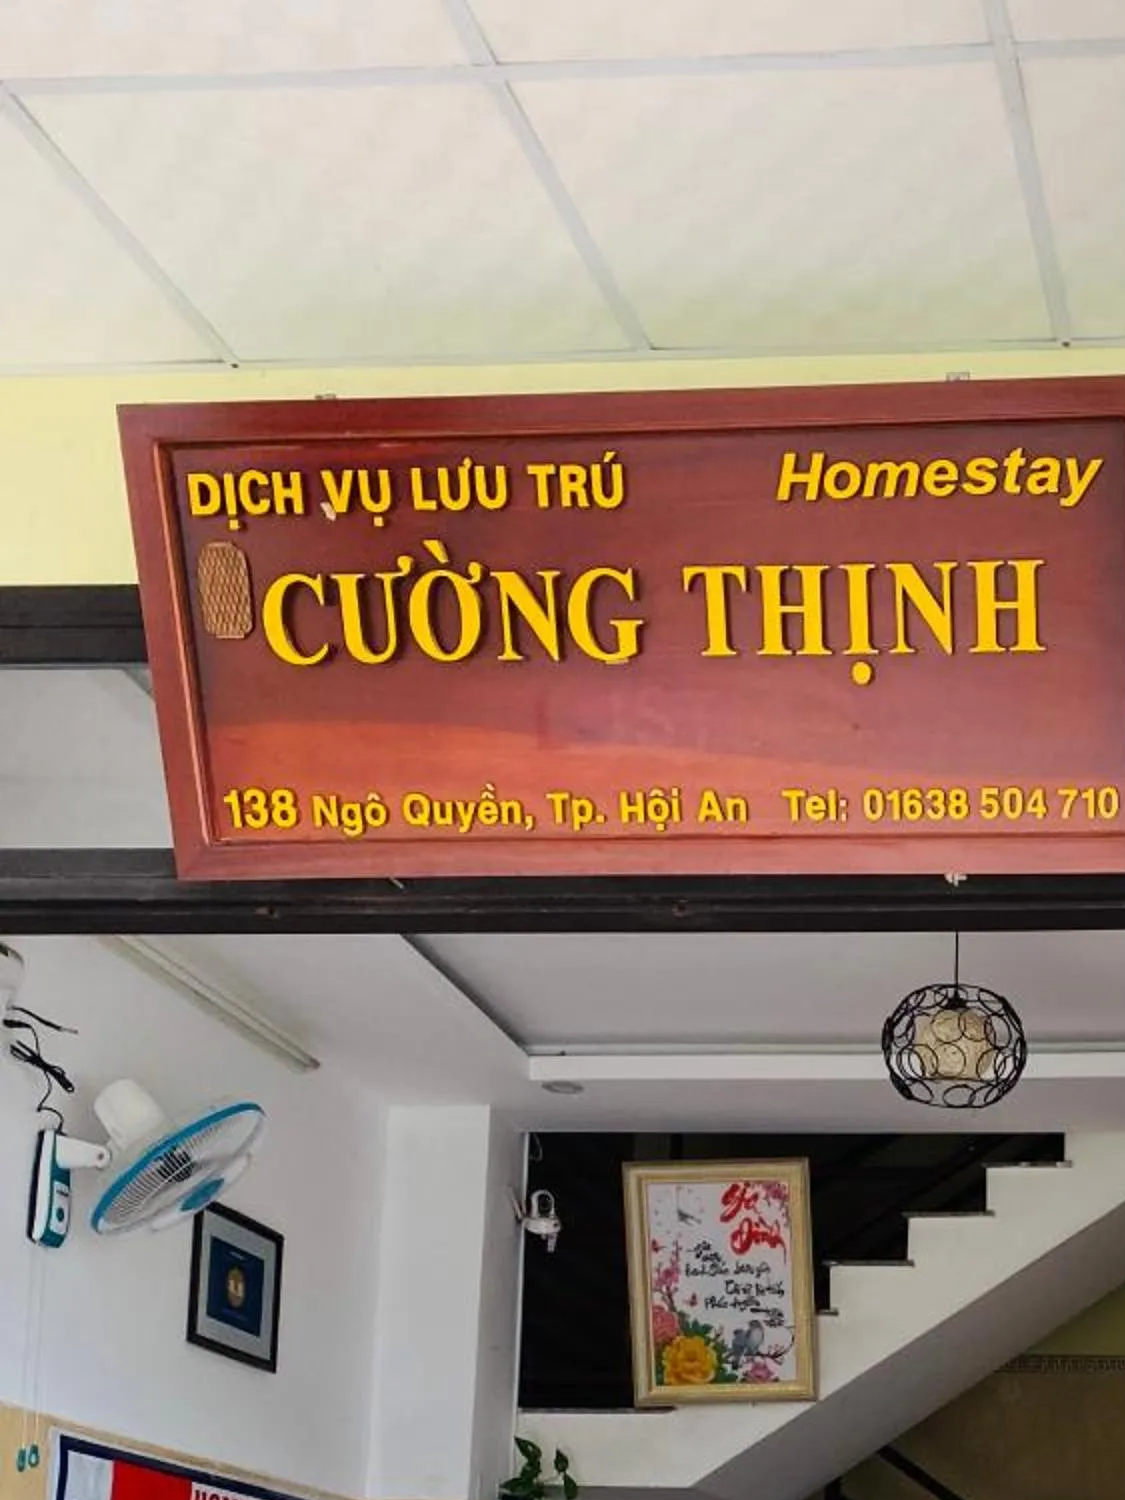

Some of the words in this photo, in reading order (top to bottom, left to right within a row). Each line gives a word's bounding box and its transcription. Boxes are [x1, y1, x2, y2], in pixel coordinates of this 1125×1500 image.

[187, 468, 305, 531] DỊCH
[320, 468, 392, 528] VỤ
[410, 456, 508, 512] LƯU
[526, 450, 625, 510] TRÚ
[776, 447, 1104, 508] Homestay
[261, 538, 645, 666] CƯỜNG
[681, 558, 1047, 686] THỊNH
[223, 787, 298, 830] 138
[312, 791, 389, 838] Ngô
[402, 783, 537, 835] Quyền,
[546, 790, 606, 832] Tp.
[619, 786, 682, 833] Hội
[696, 788, 748, 826] An
[780, 787, 849, 825] Tel:
[862, 786, 970, 823] 01638
[979, 786, 1048, 822] 504
[1057, 785, 1121, 822] 710
